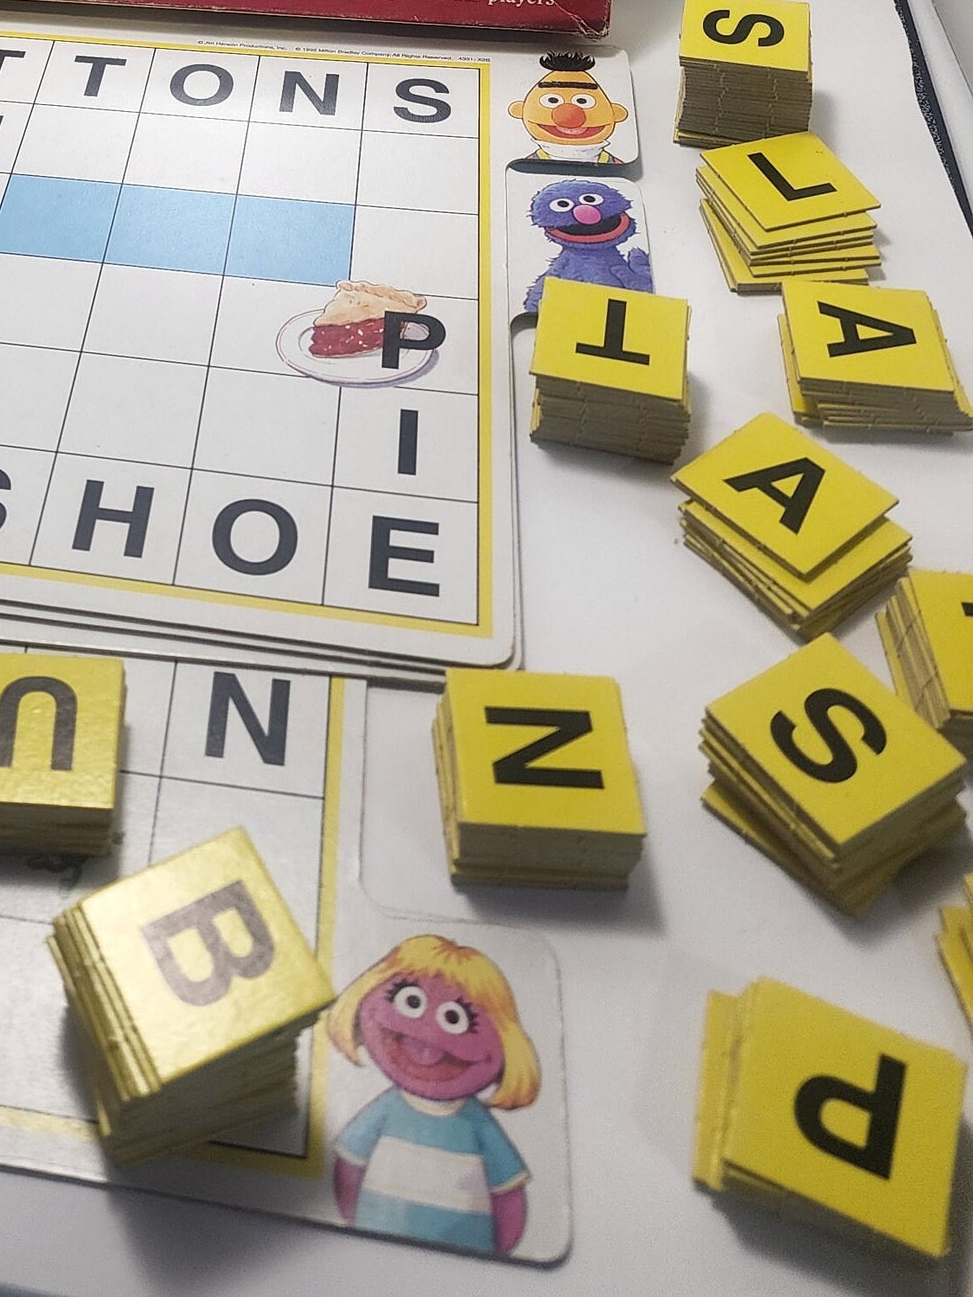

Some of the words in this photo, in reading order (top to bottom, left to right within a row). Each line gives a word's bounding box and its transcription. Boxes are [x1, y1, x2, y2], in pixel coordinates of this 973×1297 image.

[702, 8, 785, 49] S
[747, 151, 837, 202] L
[575, 298, 651, 367] T
[817, 301, 917, 358] A
[722, 456, 826, 535] A
[205, 671, 291, 767] N
[769, 687, 888, 784] S
[140, 878, 277, 1008] B
[793, 1053, 908, 1181] P
